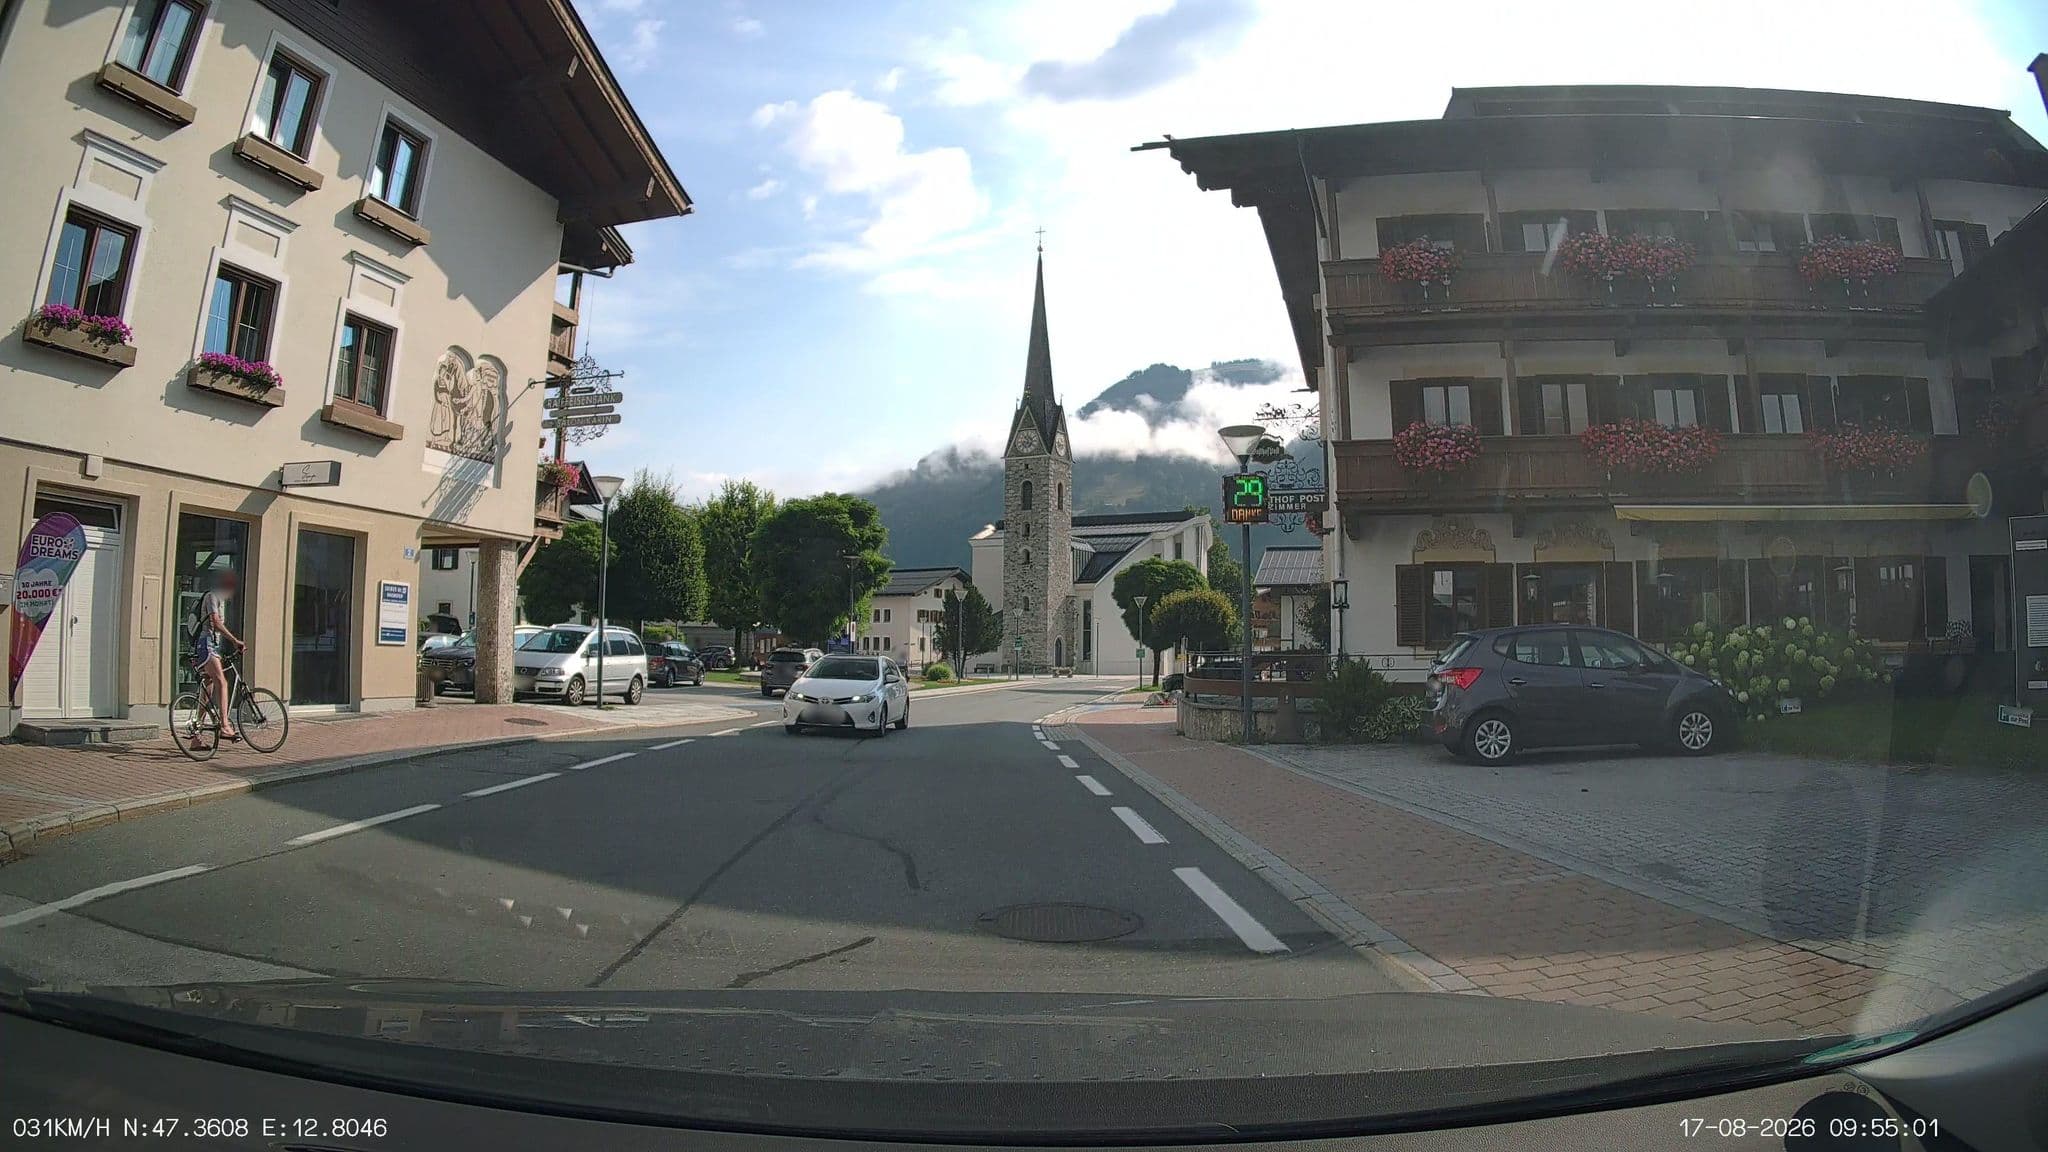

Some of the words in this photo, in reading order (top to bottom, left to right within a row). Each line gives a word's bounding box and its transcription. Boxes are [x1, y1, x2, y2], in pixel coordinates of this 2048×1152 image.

[547, 394, 615, 408] RAIFFEISENBANK
[1232, 479, 1262, 506] 29
[1269, 495, 1295, 504] THOF
[1300, 494, 1325, 503] POST
[32, 535, 64, 548] EURO
[30, 547, 79, 560] DREAMS
[31, 580, 52, 588] JAHRE
